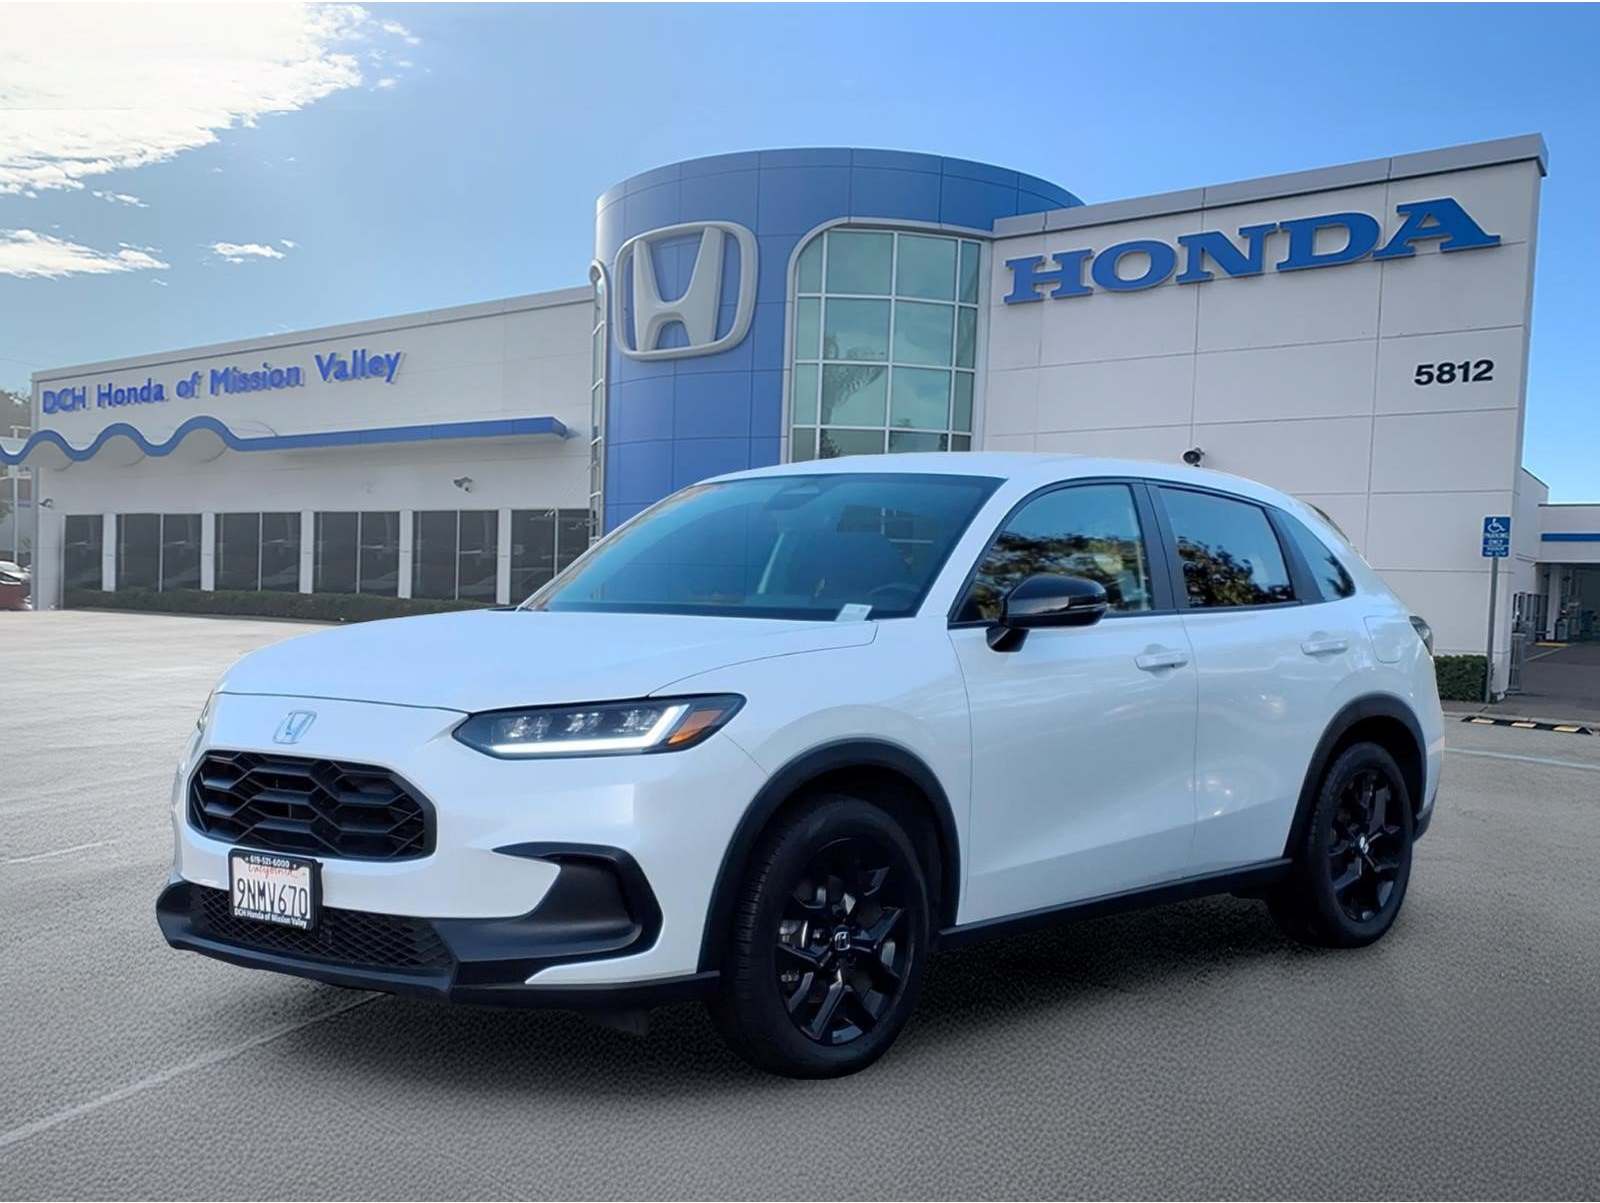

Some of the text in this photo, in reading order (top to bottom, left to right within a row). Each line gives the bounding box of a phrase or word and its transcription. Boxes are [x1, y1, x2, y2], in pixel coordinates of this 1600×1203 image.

[1004, 197, 1500, 304] HONDA
[42, 349, 402, 415] DCH Honda of Mission Valley
[1414, 359, 1494, 385] 5812
[237, 878, 308, 918] 9NMV670
